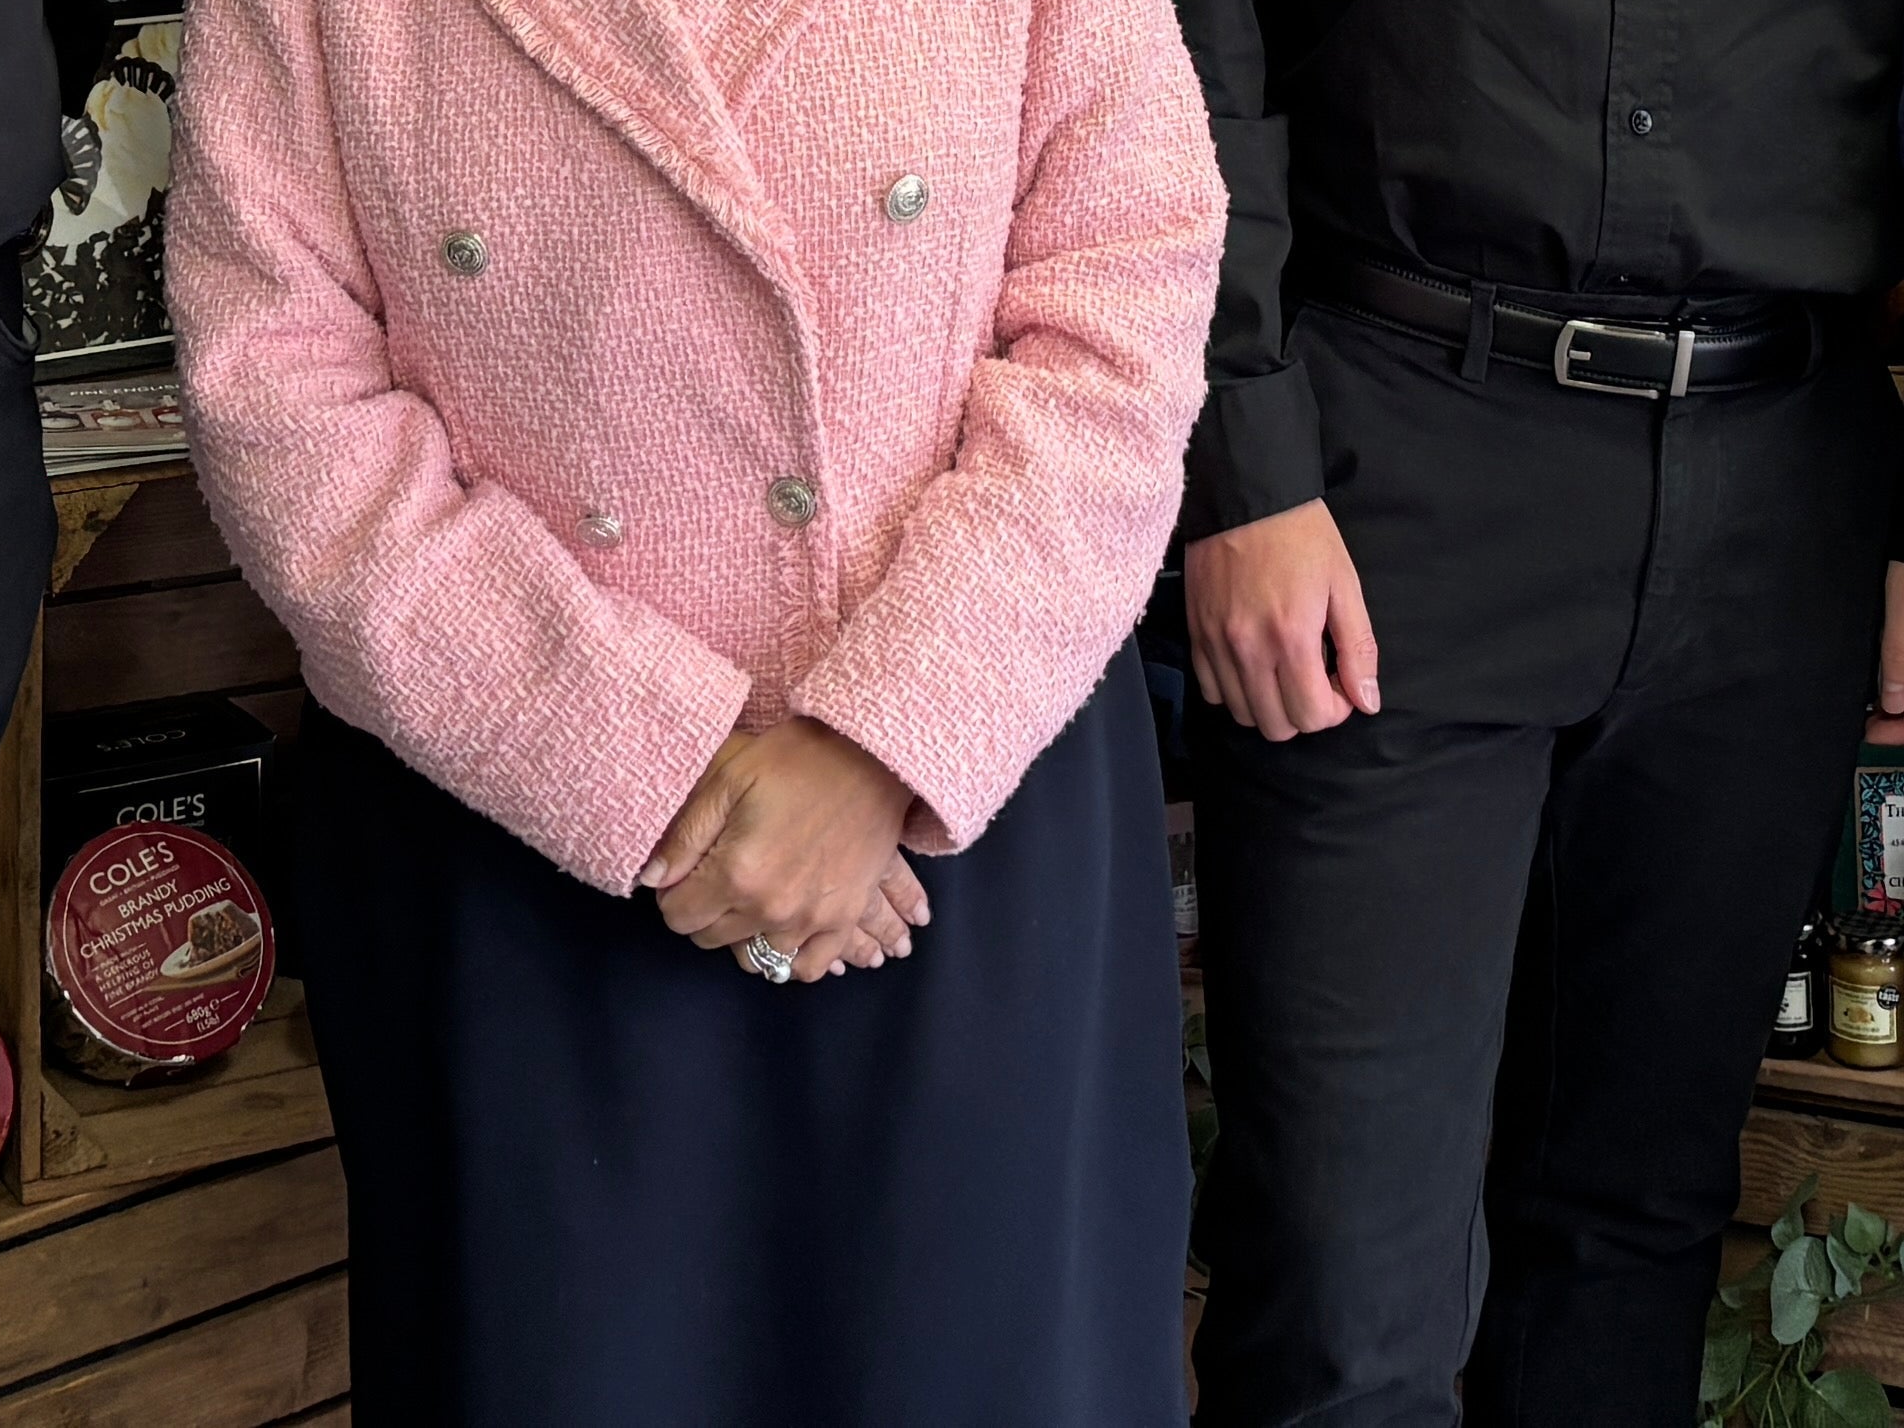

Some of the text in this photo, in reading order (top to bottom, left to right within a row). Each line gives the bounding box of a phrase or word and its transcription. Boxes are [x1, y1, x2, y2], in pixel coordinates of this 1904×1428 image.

[113, 384, 180, 394] ENGLIS
[116, 793, 205, 825] COLE'S
[89, 840, 175, 895] COLE'S
[117, 878, 179, 919] BRANDY
[80, 877, 232, 959] CHRISTMAS PUDDING
[103, 948, 152, 978] GENEROUS
[98, 967, 141, 993] HELPING
